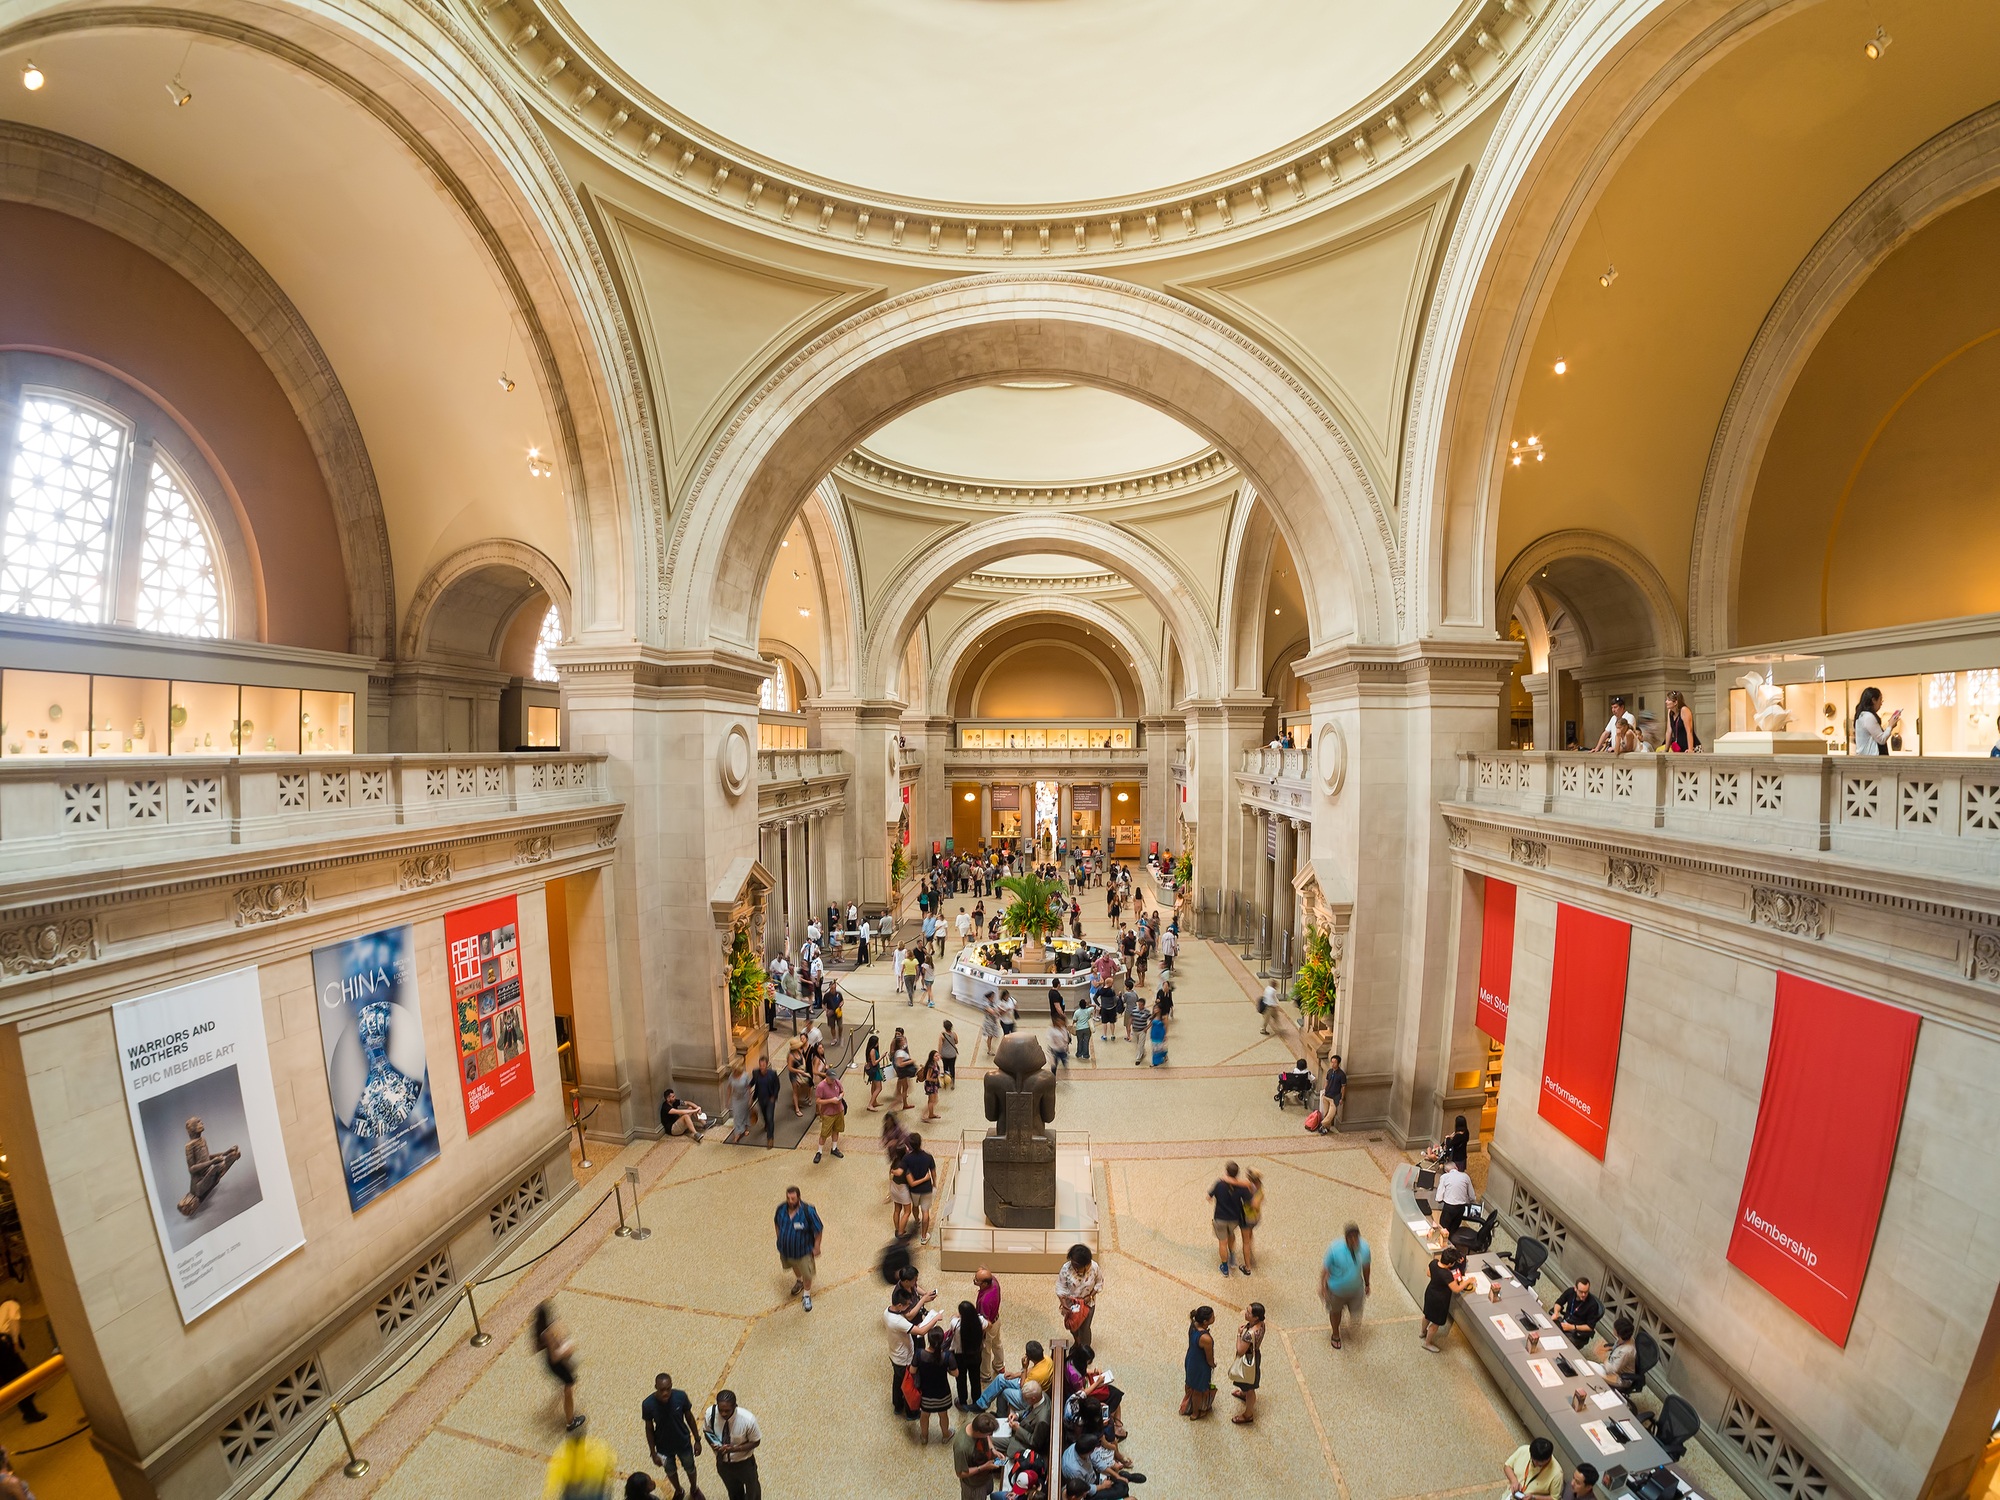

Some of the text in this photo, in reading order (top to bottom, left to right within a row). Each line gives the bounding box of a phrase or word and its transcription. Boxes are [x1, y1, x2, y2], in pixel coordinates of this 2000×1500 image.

[451, 935, 480, 964] ASIA
[453, 955, 481, 985] 100
[323, 966, 391, 1009] CHINA
[1480, 987, 1493, 1005] Met
[127, 1021, 215, 1058] WARRIORS AND
[130, 1042, 189, 1071] MOTHERS
[133, 1043, 235, 1090] EPIC MBEMBE ART
[467, 1087, 477, 1097] THE
[1545, 1075, 1591, 1115] Performances
[1743, 1207, 1817, 1266] Membership
